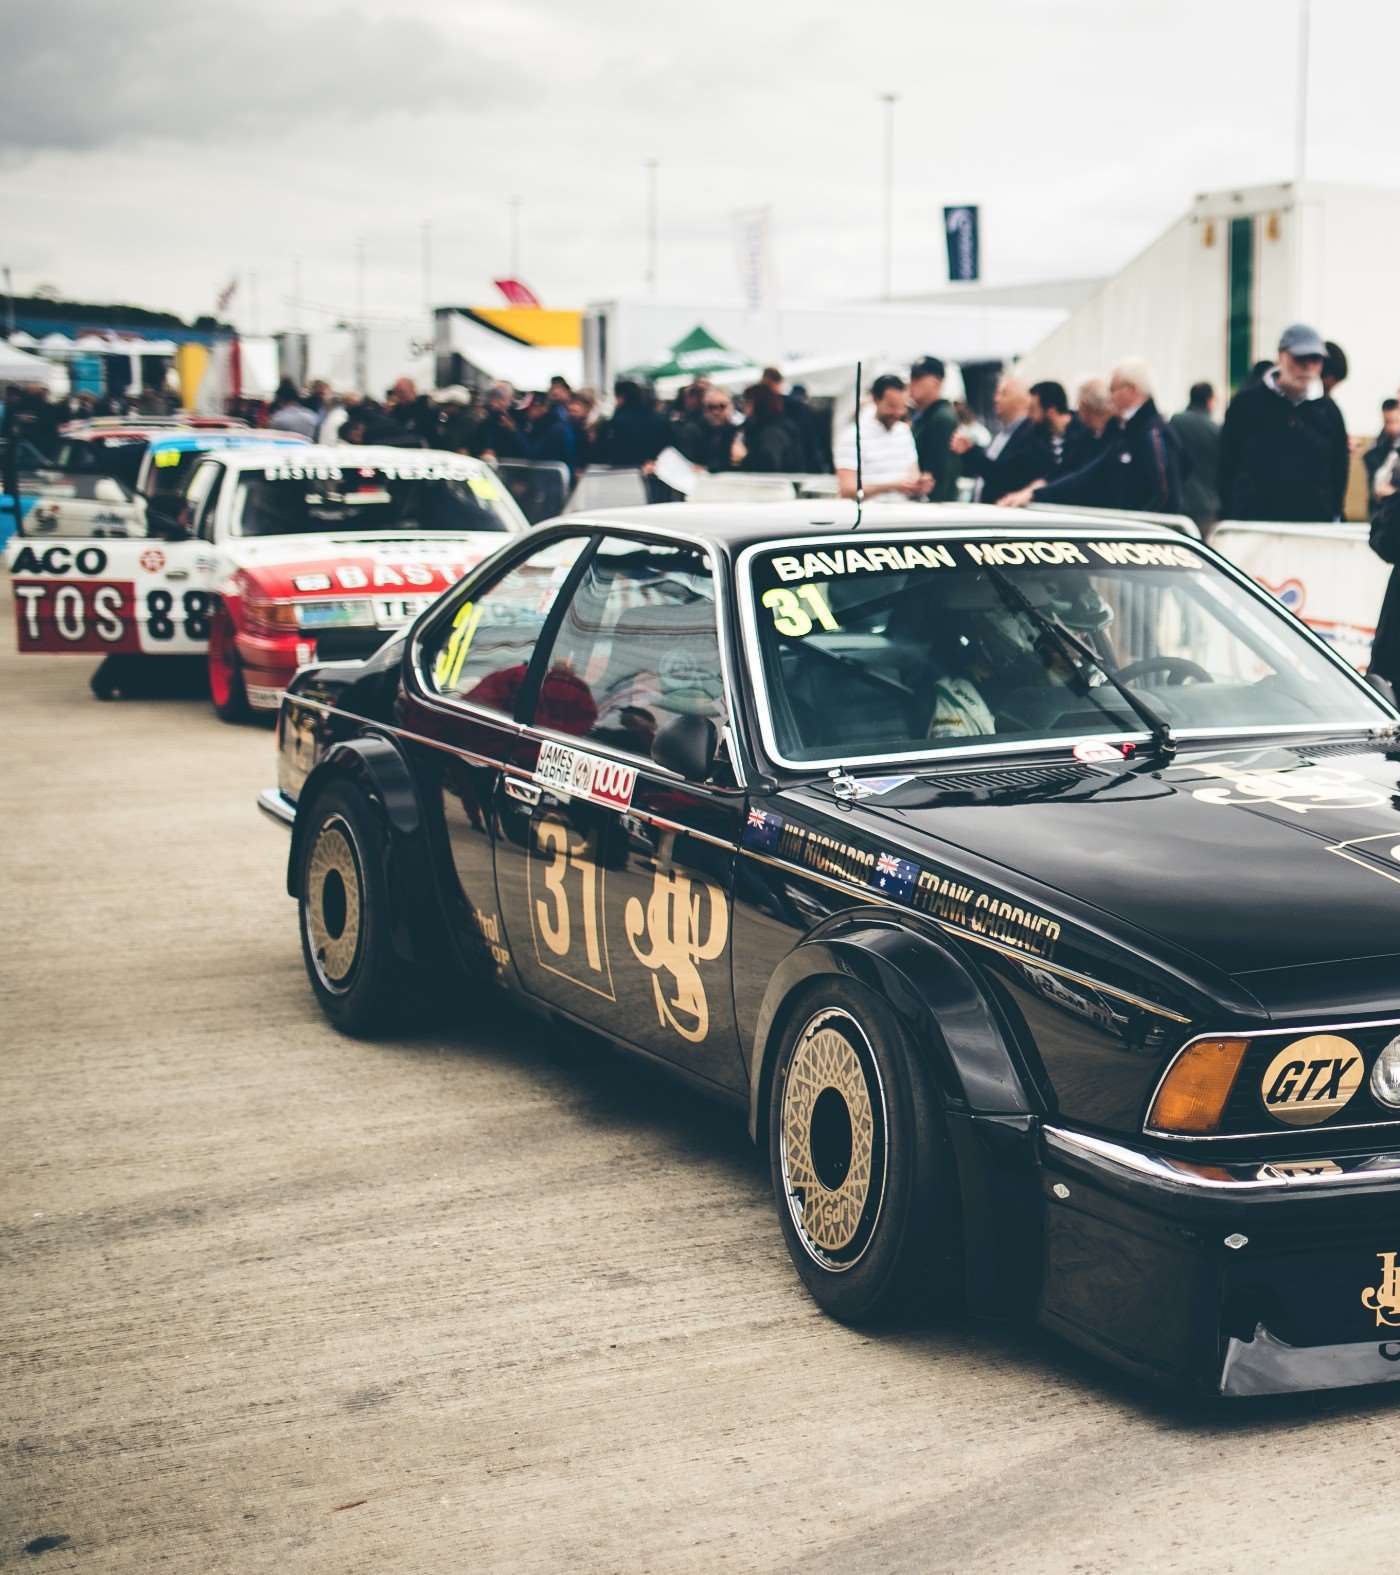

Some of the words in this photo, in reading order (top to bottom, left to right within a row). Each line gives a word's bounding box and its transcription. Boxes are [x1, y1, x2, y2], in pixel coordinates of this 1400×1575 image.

[771, 545, 956, 582] BAVARIAN
[964, 542, 1089, 568] MOTOR
[1087, 542, 1203, 570] WORKS
[16, 585, 125, 641] TOS
[146, 590, 214, 641] 88
[762, 583, 840, 637] 31
[541, 743, 575, 769] JAMES
[592, 764, 633, 799] 1000
[779, 823, 806, 859] JIM
[804, 831, 875, 885] RICHARDS
[535, 822, 602, 972] 31
[914, 871, 975, 926] FRANK
[970, 894, 1062, 961] GARDNER
[1266, 1057, 1359, 1105] GTX
